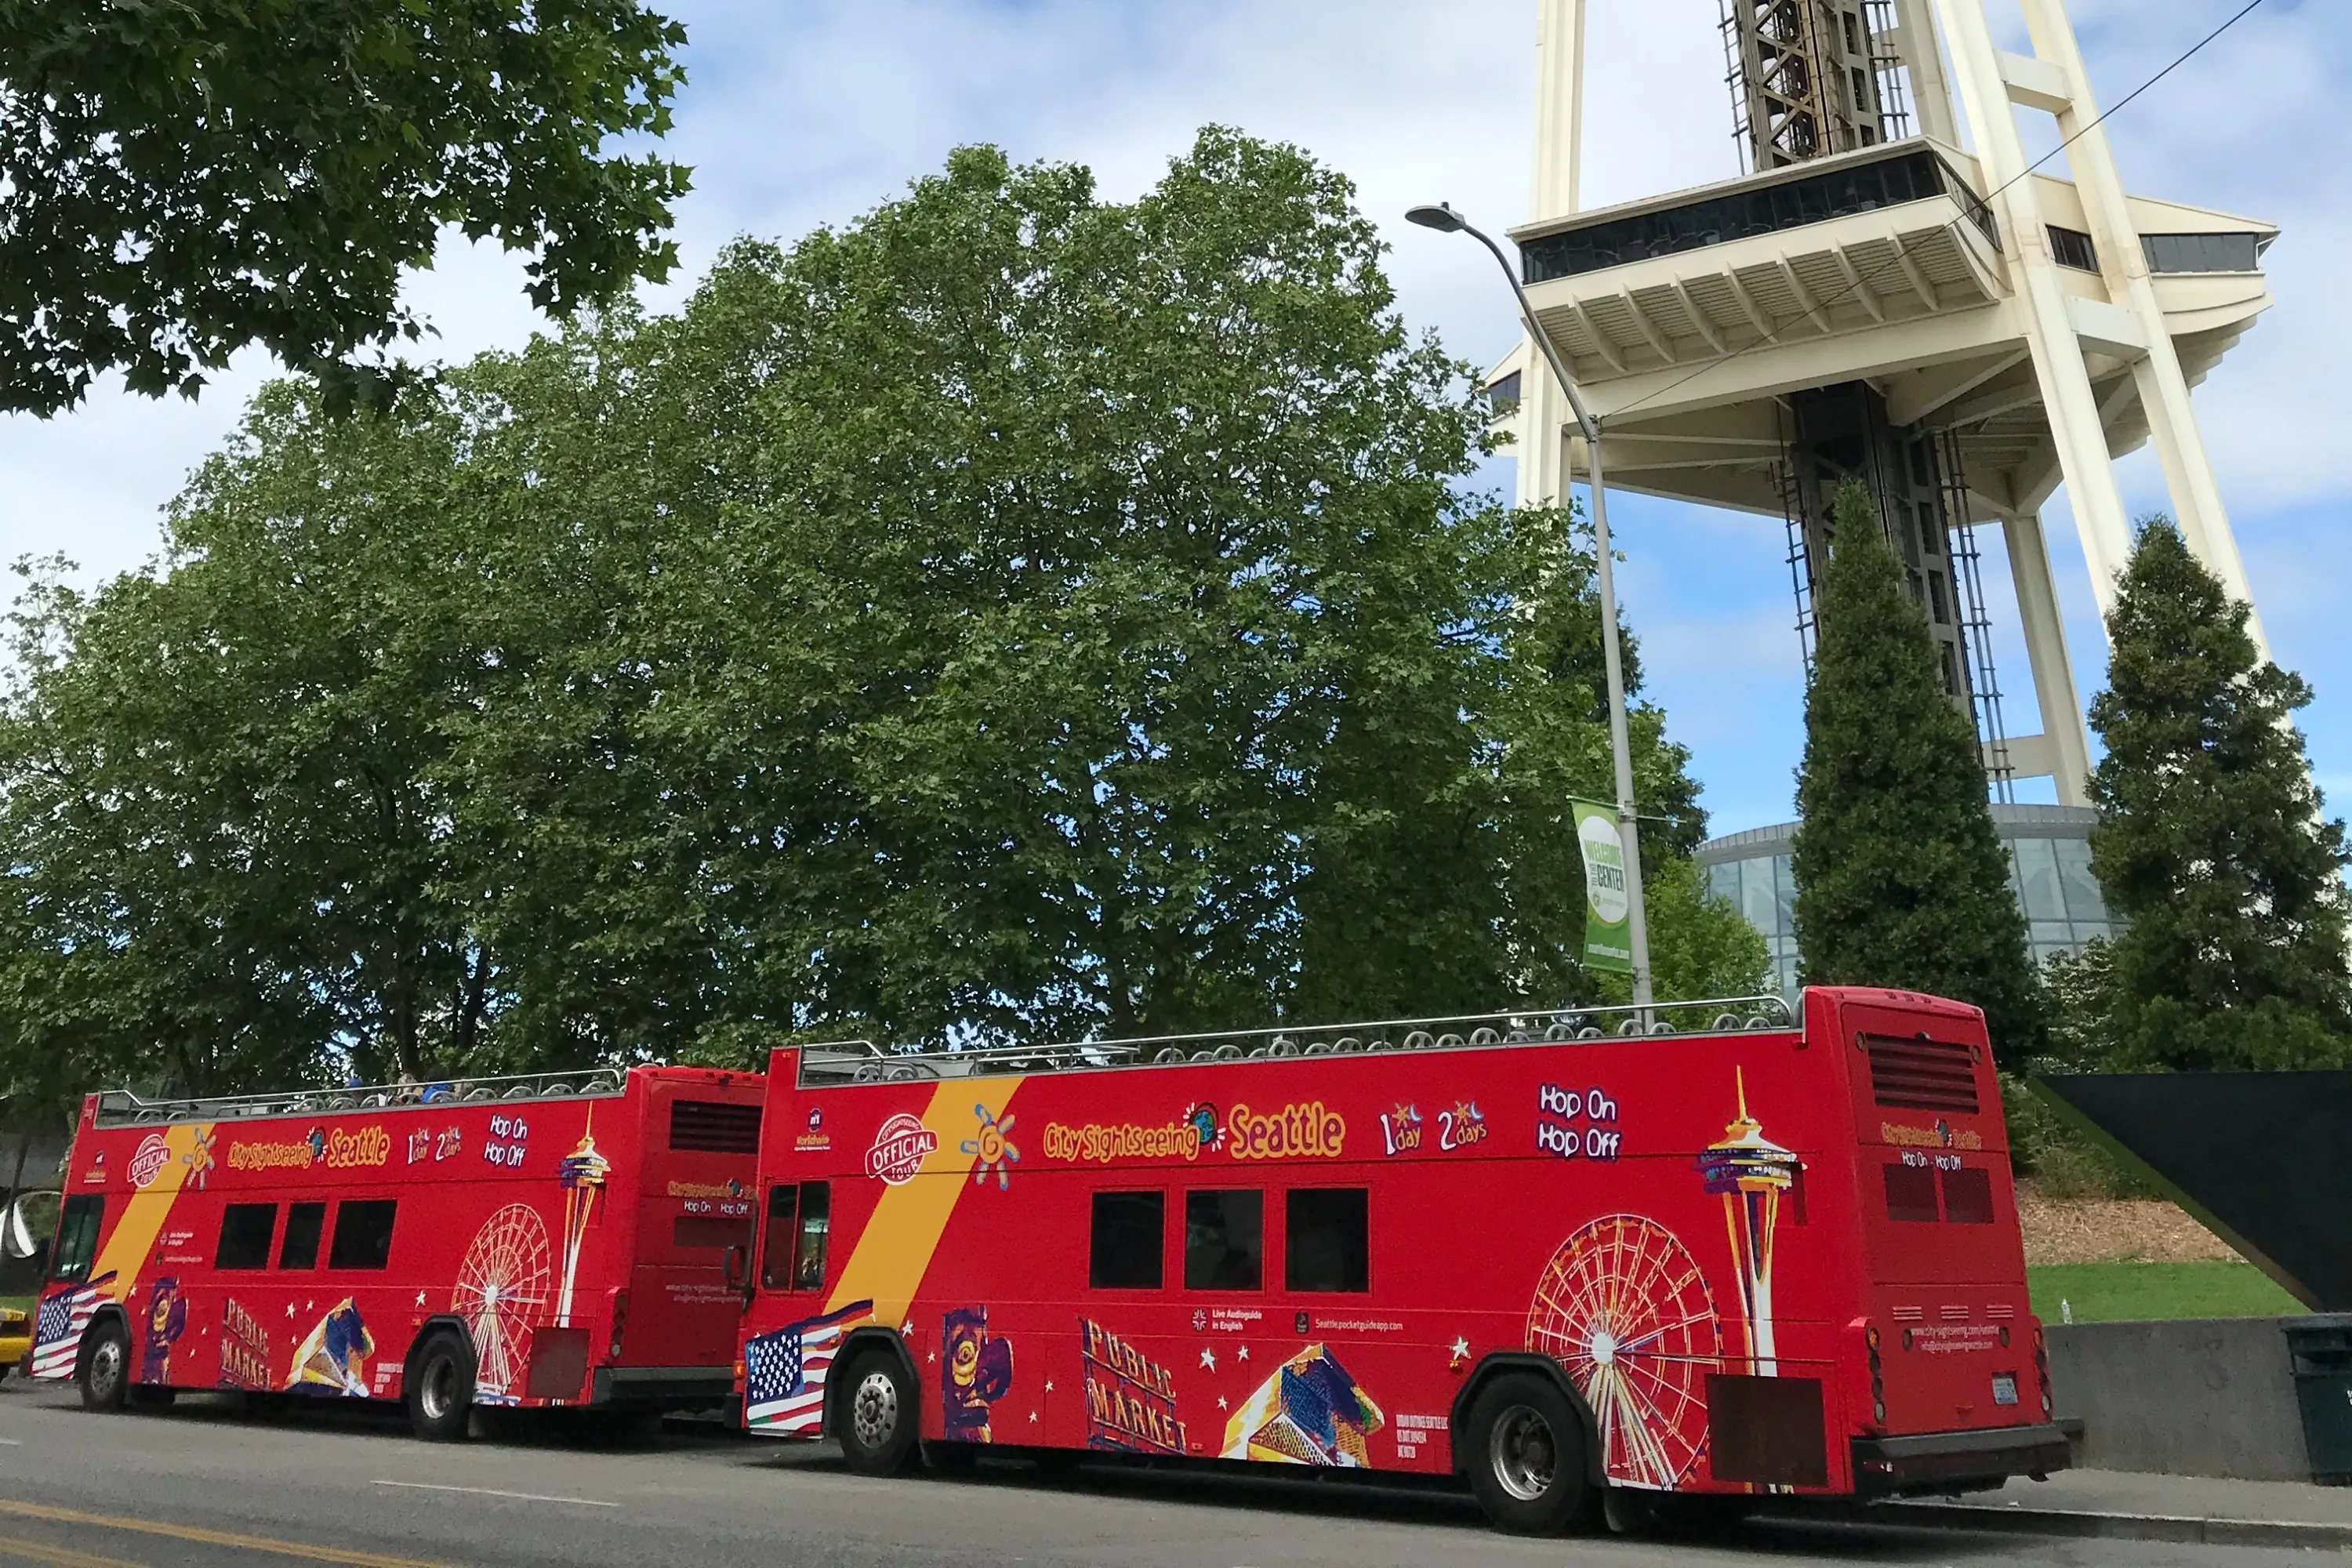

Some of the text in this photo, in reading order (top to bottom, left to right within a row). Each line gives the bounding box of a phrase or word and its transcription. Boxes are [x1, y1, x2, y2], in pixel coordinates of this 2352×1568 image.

[1584, 839, 1621, 866] WELCOME
[1596, 864, 1624, 892] CENTER
[1541, 1085, 1616, 1120] Hop On
[490, 1115, 528, 1139] Hop On
[1229, 1101, 1345, 1160] Seattle
[1396, 1127, 1421, 1150] day
[1438, 1112, 1486, 1150] 2 days
[328, 1125, 390, 1168] Seattle
[484, 1142, 525, 1167] Hop Off
[873, 1134, 935, 1170] OFFICIAL
[1539, 1123, 1621, 1159] Hop Off
[132, 1149, 169, 1174] OFFICIAL
[891, 1160, 919, 1180] TOUR
[1901, 1150, 1916, 1167] Hop
[1917, 1151, 1928, 1167] On
[1935, 1155, 1950, 1171] Hop
[1950, 1155, 1962, 1171] Off
[684, 1200, 748, 1214] Hop On Hop Off
[1220, 1321, 1243, 1332] English
[1087, 1319, 1176, 1399] PUBLIC
[1087, 1377, 1186, 1447] MARKET
